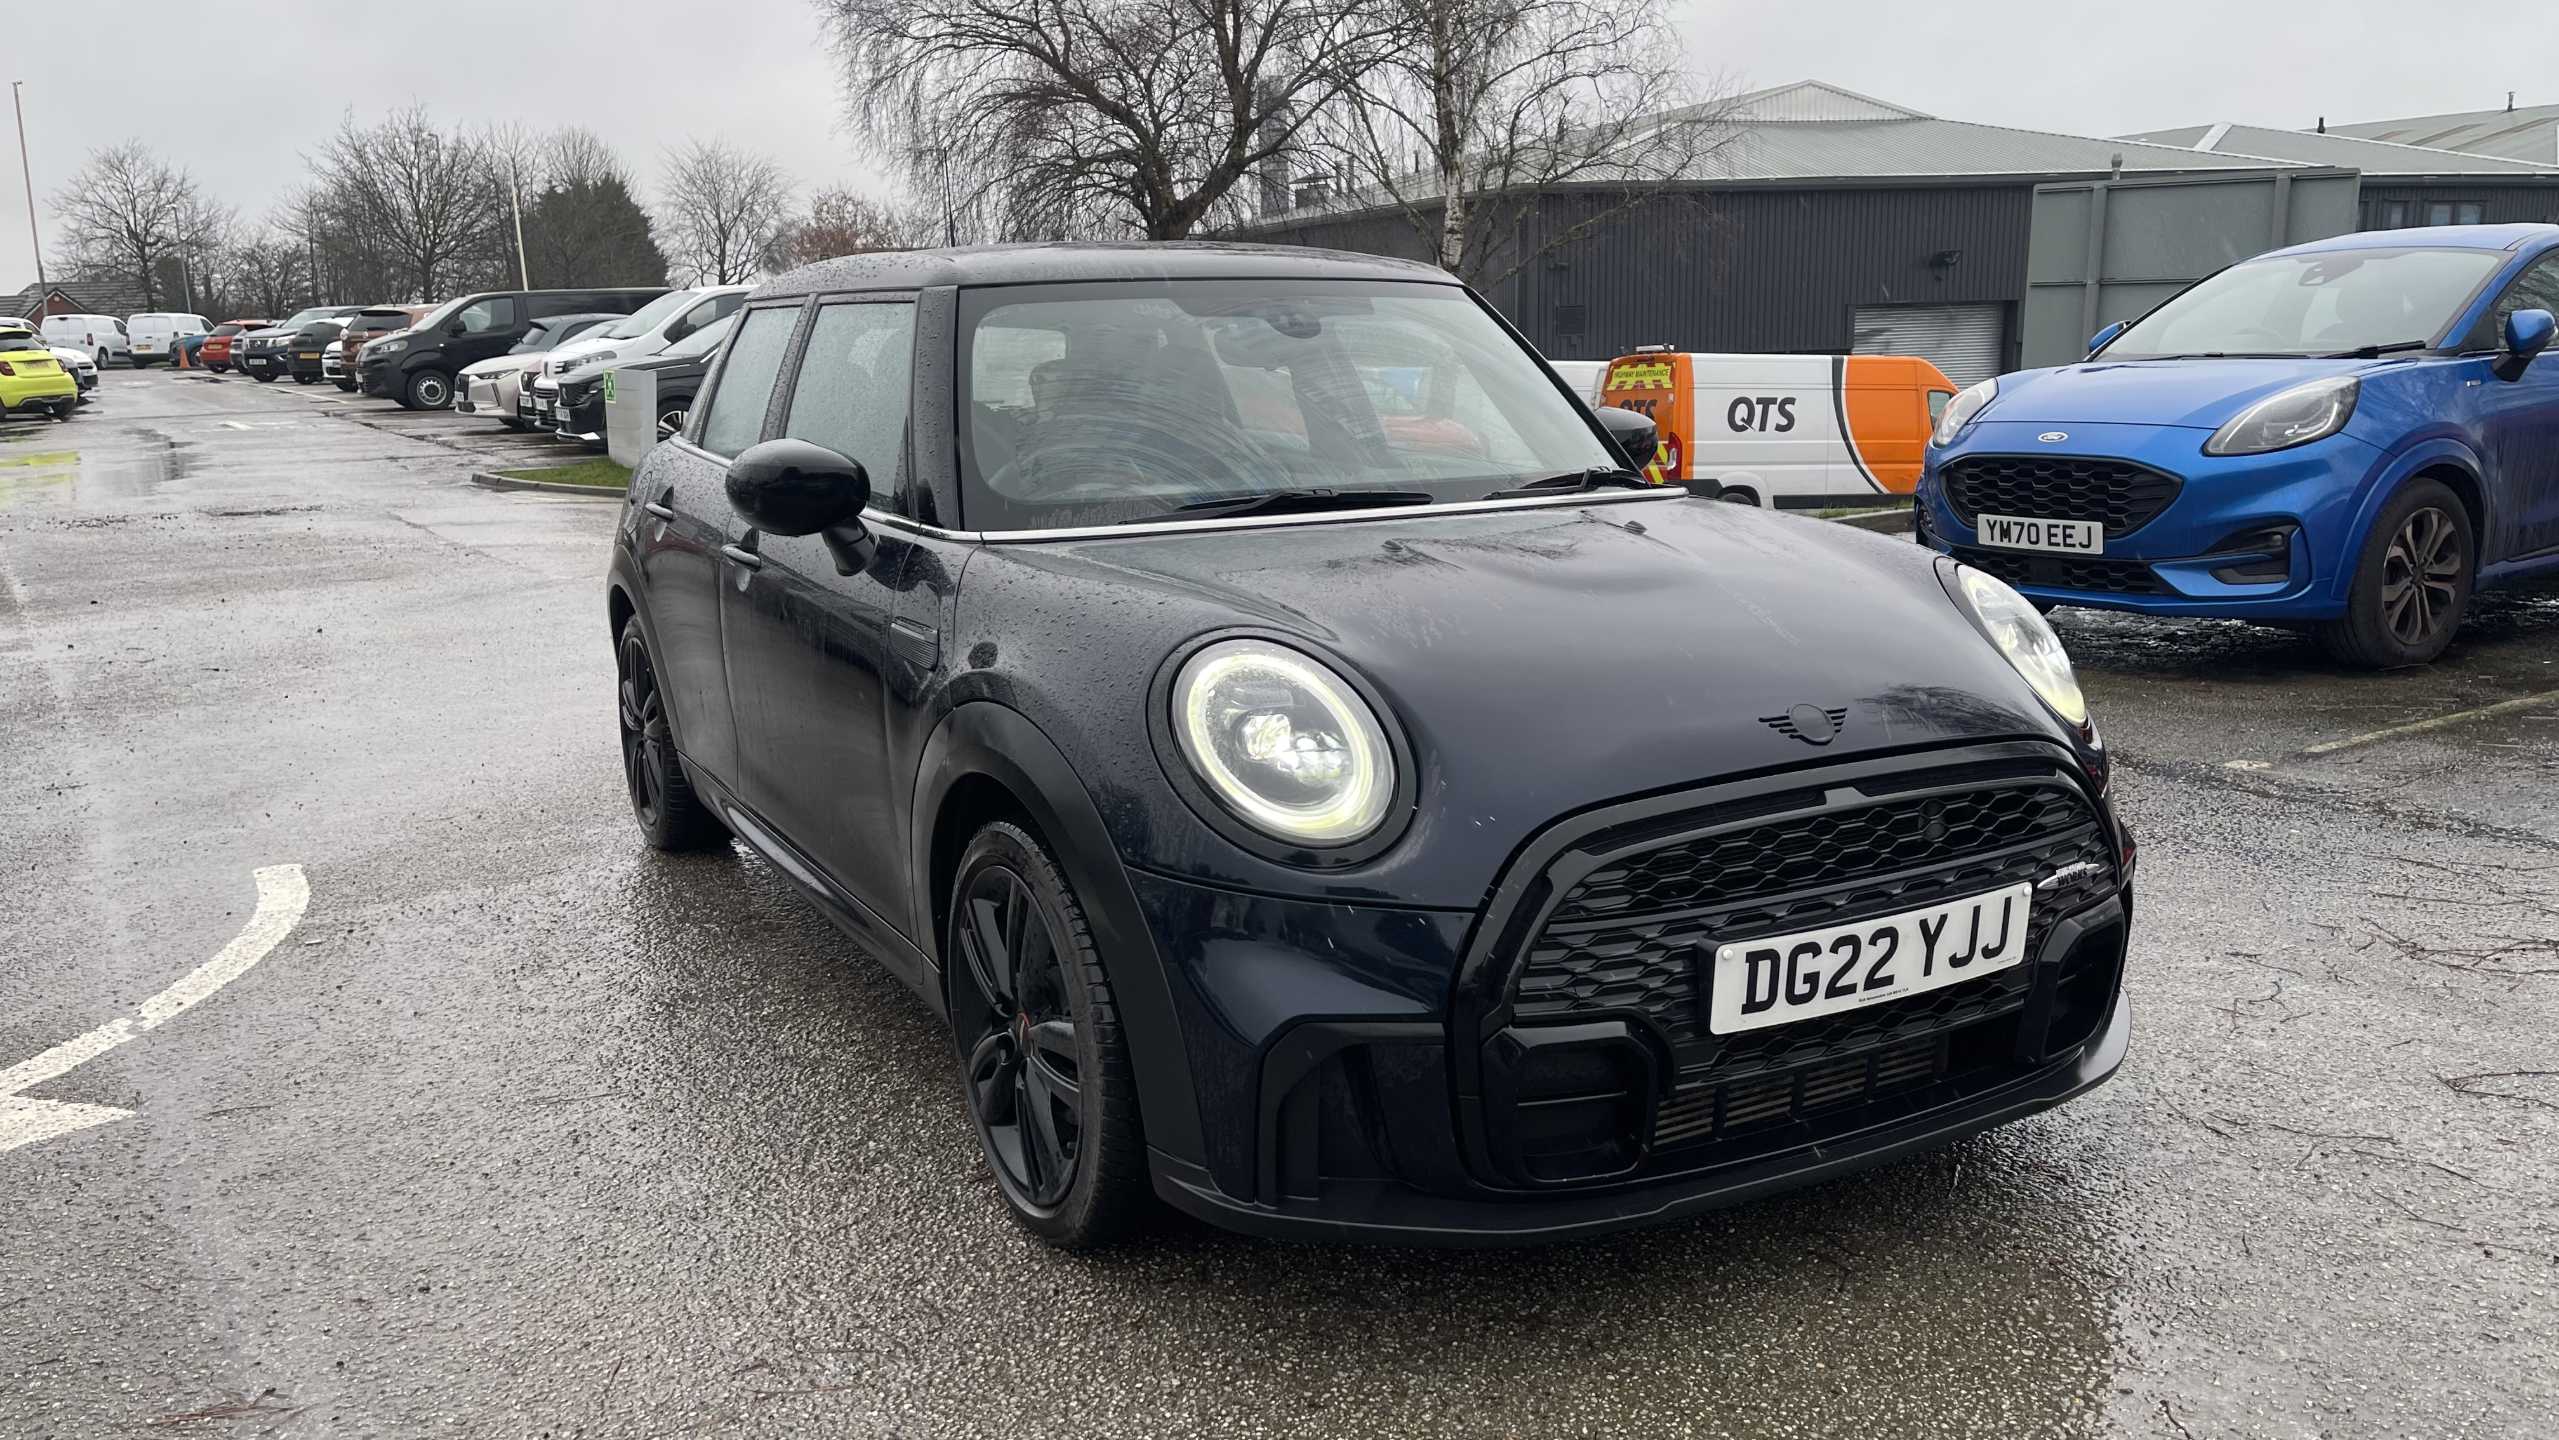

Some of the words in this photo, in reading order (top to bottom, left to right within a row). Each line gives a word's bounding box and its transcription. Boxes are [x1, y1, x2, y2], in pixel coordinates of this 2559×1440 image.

[1635, 367, 1670, 377] MAINTENANCE
[1727, 396, 1797, 433] QTS
[1986, 518, 2040, 545] YM70
[2046, 523, 2092, 549] EEJ
[1740, 925, 1900, 1016] DG22
[1918, 895, 2013, 977] YJJ
